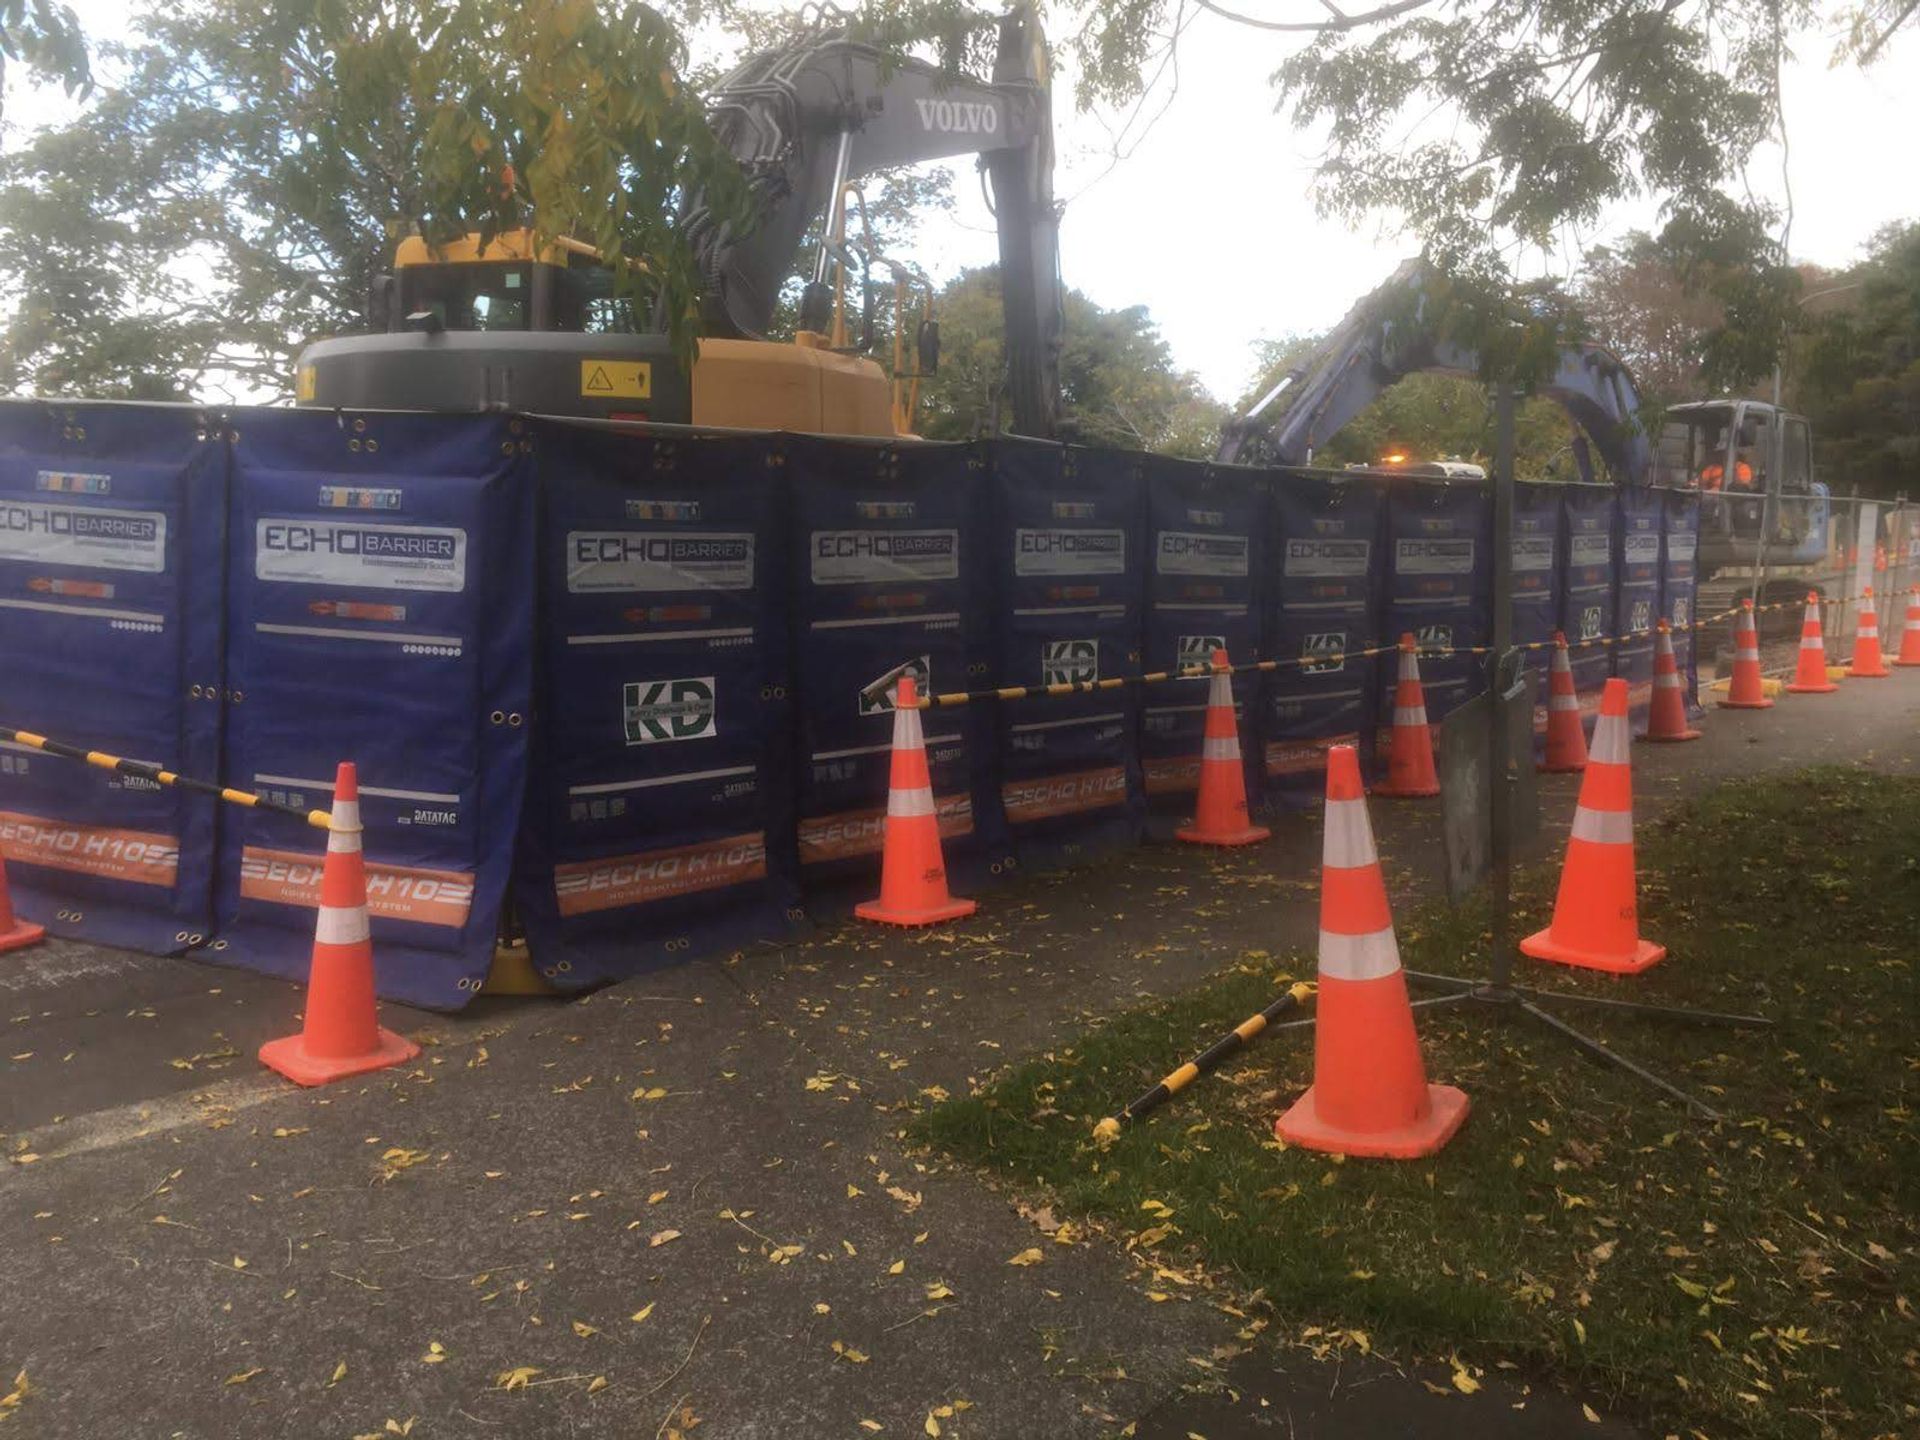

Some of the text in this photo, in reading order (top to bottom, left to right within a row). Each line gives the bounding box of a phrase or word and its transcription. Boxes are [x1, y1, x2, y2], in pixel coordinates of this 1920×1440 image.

[915, 99, 997, 133] VOLVO
[76, 519, 153, 536] BARRIER
[265, 526, 451, 554] ECHO BARRIER
[577, 538, 744, 562] ECHO BARRIER
[819, 536, 891, 558] ECHO
[1021, 533, 1076, 553] ECHO
[1044, 642, 1097, 684] KD
[625, 680, 713, 740] KD
[414, 809, 457, 825] DATATAG
[84, 835, 145, 862] H10
[366, 874, 438, 901] H10
[589, 858, 680, 890] ECHO
